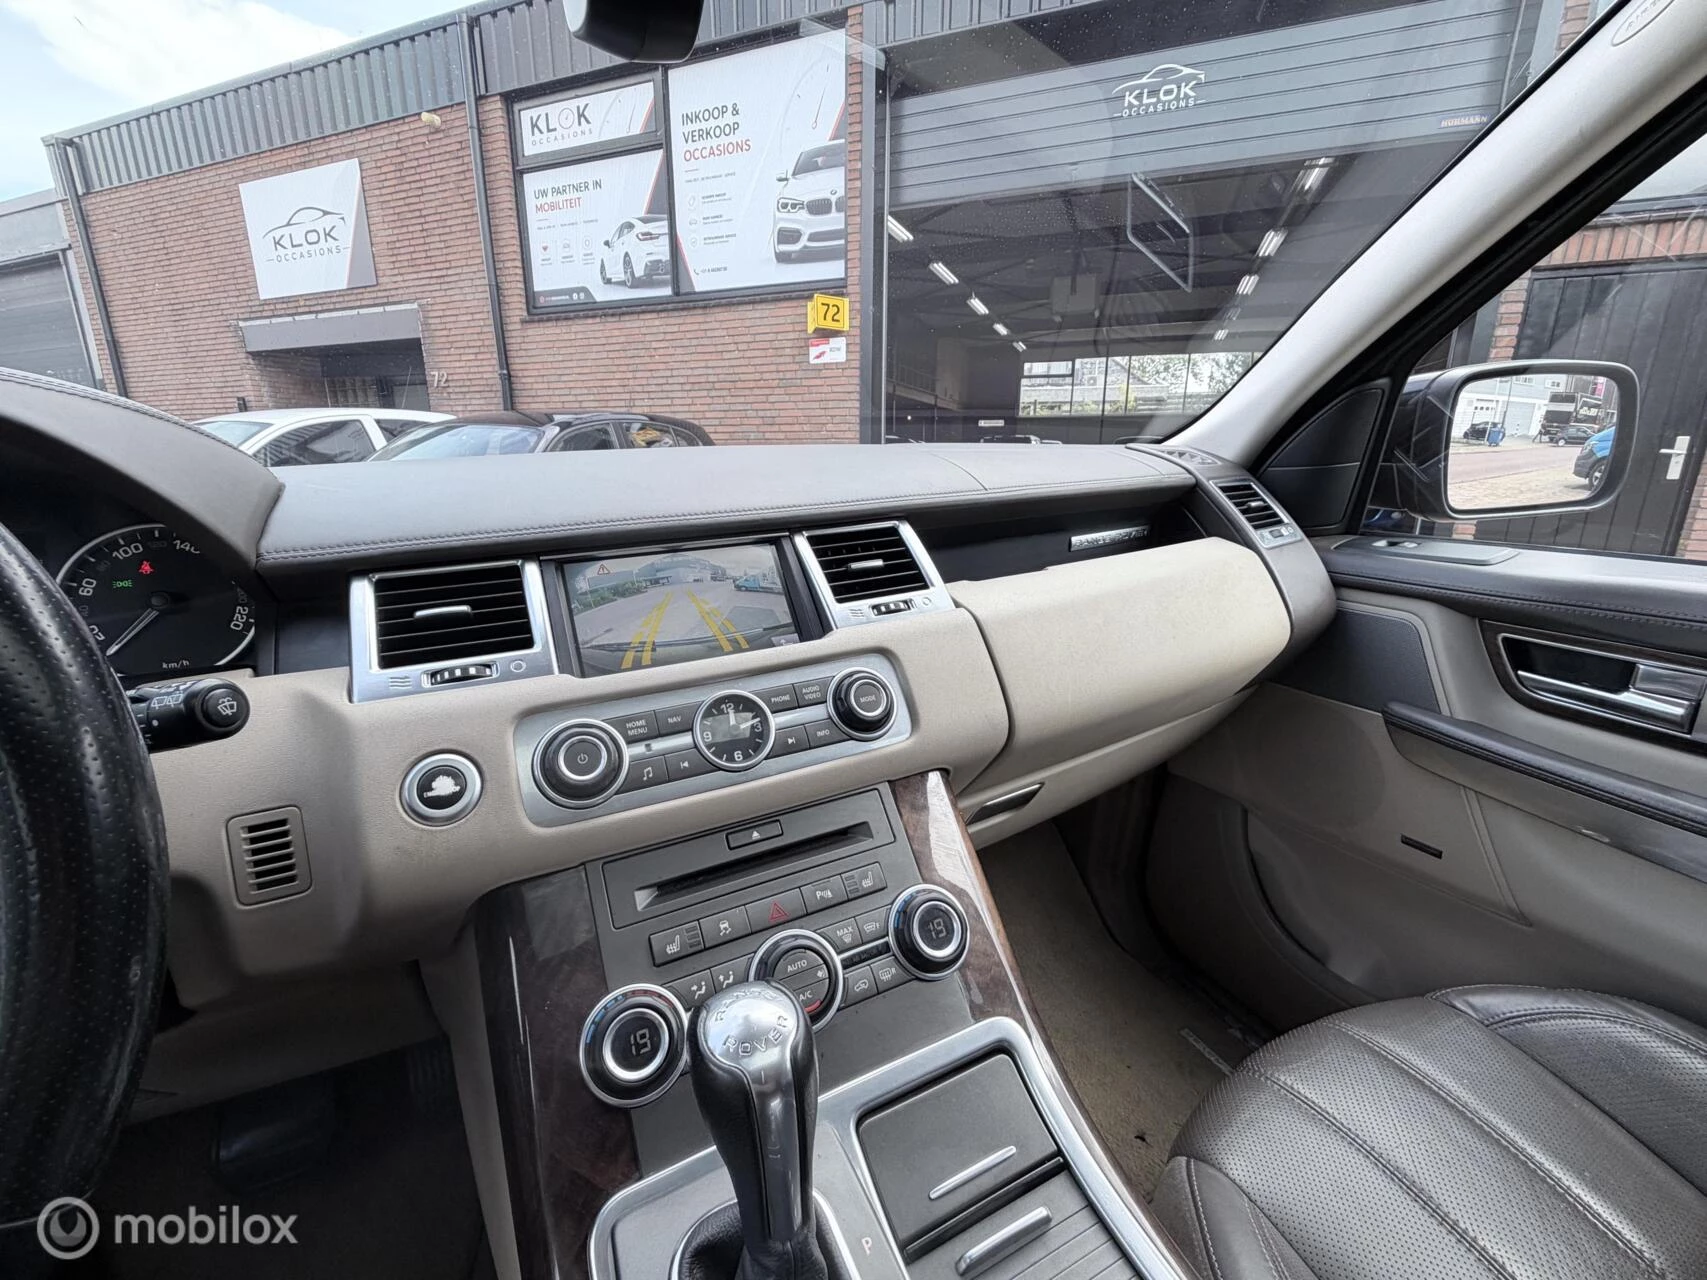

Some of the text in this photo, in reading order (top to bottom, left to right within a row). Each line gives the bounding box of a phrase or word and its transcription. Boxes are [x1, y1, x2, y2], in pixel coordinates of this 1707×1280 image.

[1124, 80, 1198, 107] KLOK
[681, 103, 740, 127] INKOOP &
[1122, 98, 1195, 118] OCCASIONS
[529, 102, 592, 137] KLOK
[531, 128, 593, 146] OCCASIONS
[682, 121, 740, 144] VERKOOP
[683, 138, 752, 162] OCCASIONS
[534, 179, 602, 200] UW PARTNER IN
[535, 197, 582, 214] MOBILITEIT
[272, 225, 340, 251] KLOK
[276, 246, 341, 263] OCCASIONS
[821, 302, 841, 323] 72
[430, 371, 448, 388] 72
[112, 542, 143, 560] 100
[79, 578, 97, 597] 60
[231, 606, 249, 631] 220
[162, 660, 190, 669] km/h
[771, 693, 791, 703] PHONE
[802, 685, 820, 696] AUDIO
[804, 690, 821, 700] VIDEO
[860, 694, 876, 704] MODE
[625, 718, 647, 730] HOME
[667, 714, 682, 725] NAV
[754, 722, 762, 732] 3
[627, 726, 648, 737] MENU
[703, 731, 712, 742] 9
[816, 729, 830, 737] INFO
[734, 750, 743, 761] 6
[836, 925, 853, 937] MAX
[927, 917, 945, 939] 19
[787, 959, 808, 973] AUTO
[630, 1028, 652, 1055] 19
[723, 1015, 789, 1055] ROVER
[861, 1236, 873, 1256] P
